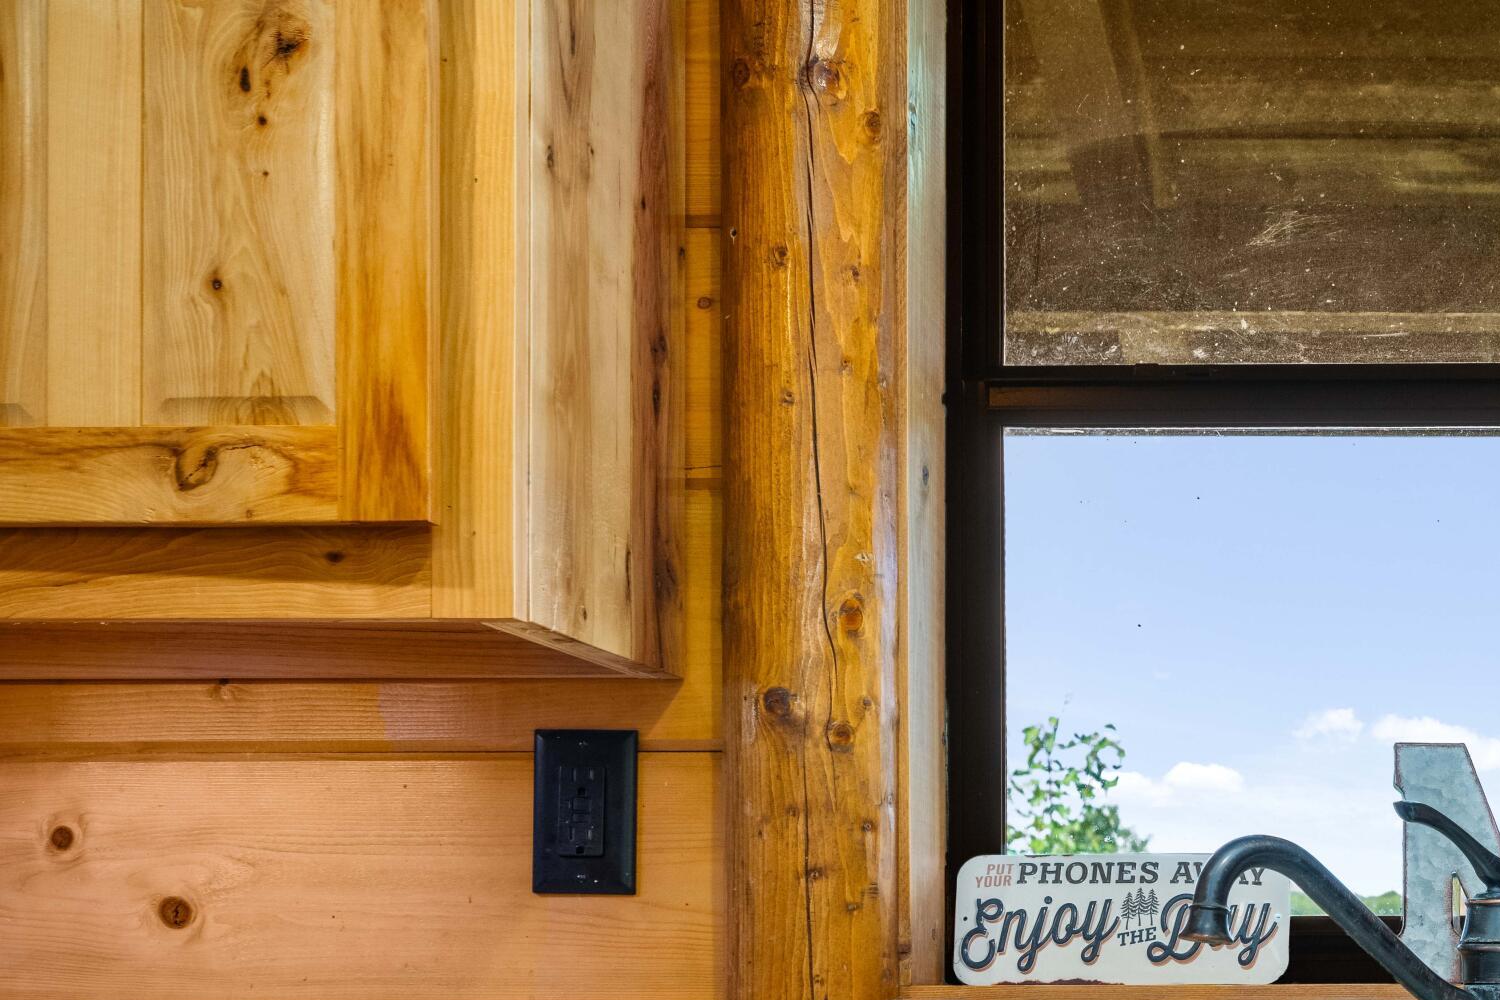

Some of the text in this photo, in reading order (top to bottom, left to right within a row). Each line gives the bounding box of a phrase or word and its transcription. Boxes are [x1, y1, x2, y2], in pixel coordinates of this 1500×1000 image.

[986, 863, 1015, 875] PUT
[1016, 861, 1263, 886] PHONES AY
[975, 875, 1012, 888] YOUR
[961, 895, 1121, 973] Enjoy
[1116, 926, 1157, 947] THE
